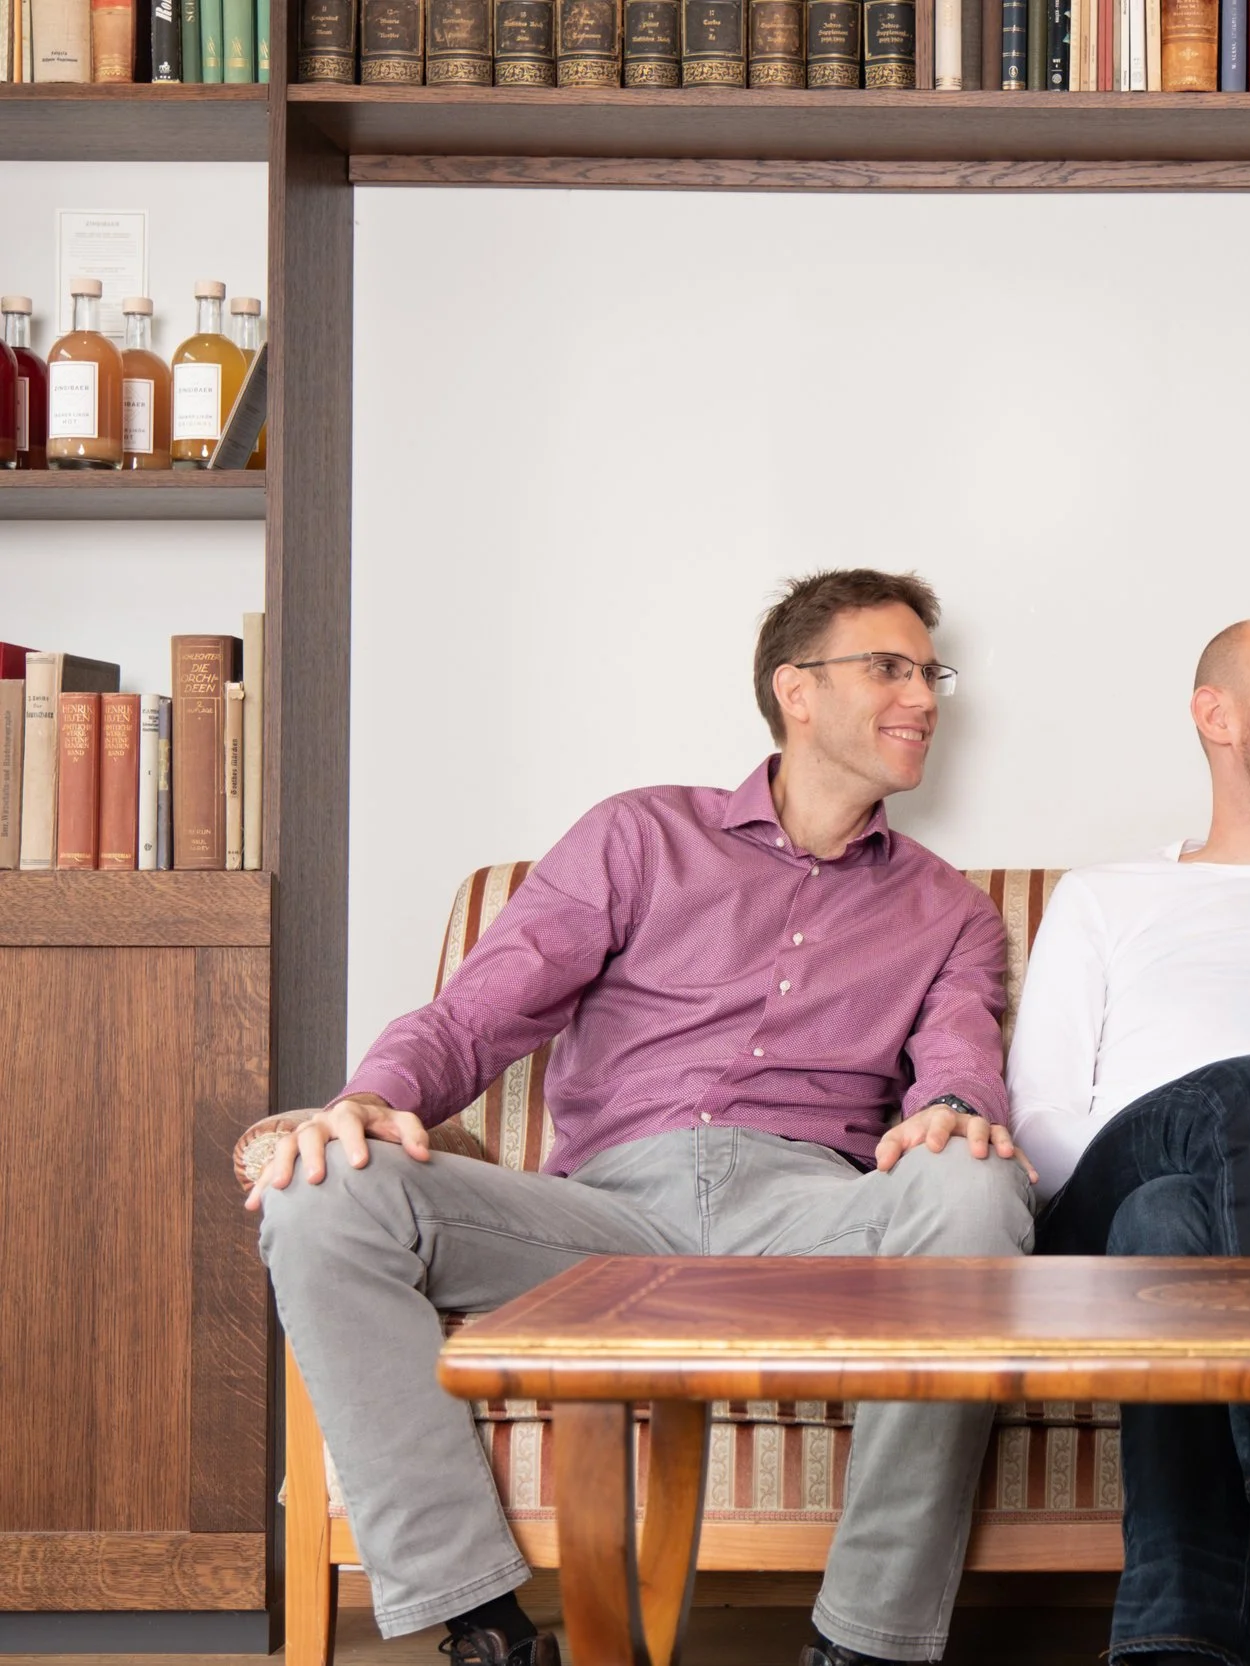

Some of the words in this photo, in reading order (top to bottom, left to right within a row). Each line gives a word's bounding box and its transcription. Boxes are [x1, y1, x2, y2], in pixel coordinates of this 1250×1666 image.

[191, 663, 210, 673] DIE
[181, 673, 219, 683] ORCHI-
[184, 684, 217, 693] DEEN
[62, 704, 94, 714] HENRIK
[104, 704, 133, 714] HENRIK
